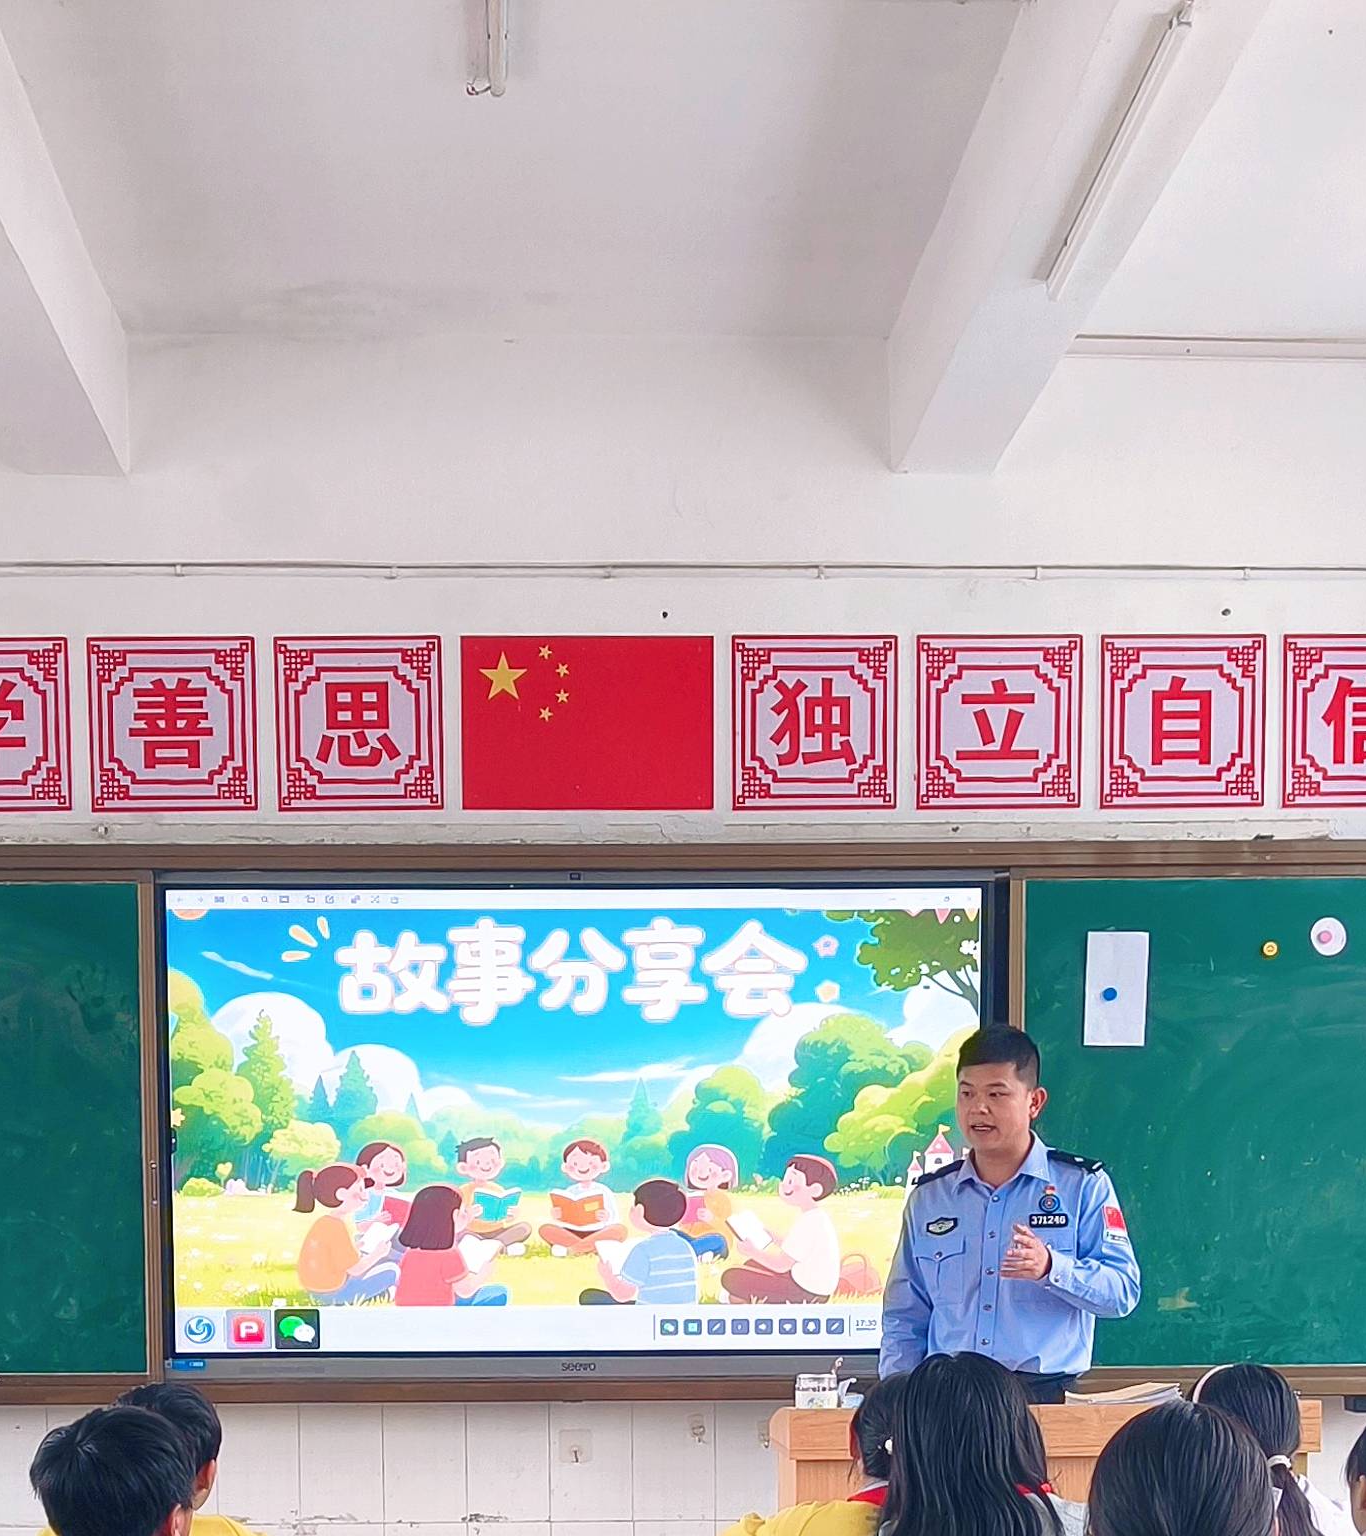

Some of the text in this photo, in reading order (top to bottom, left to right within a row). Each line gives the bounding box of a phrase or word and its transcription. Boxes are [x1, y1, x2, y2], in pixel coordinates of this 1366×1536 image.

[334, 916, 809, 1025] 故事分享会
[561, 1361, 596, 1372] seewo
